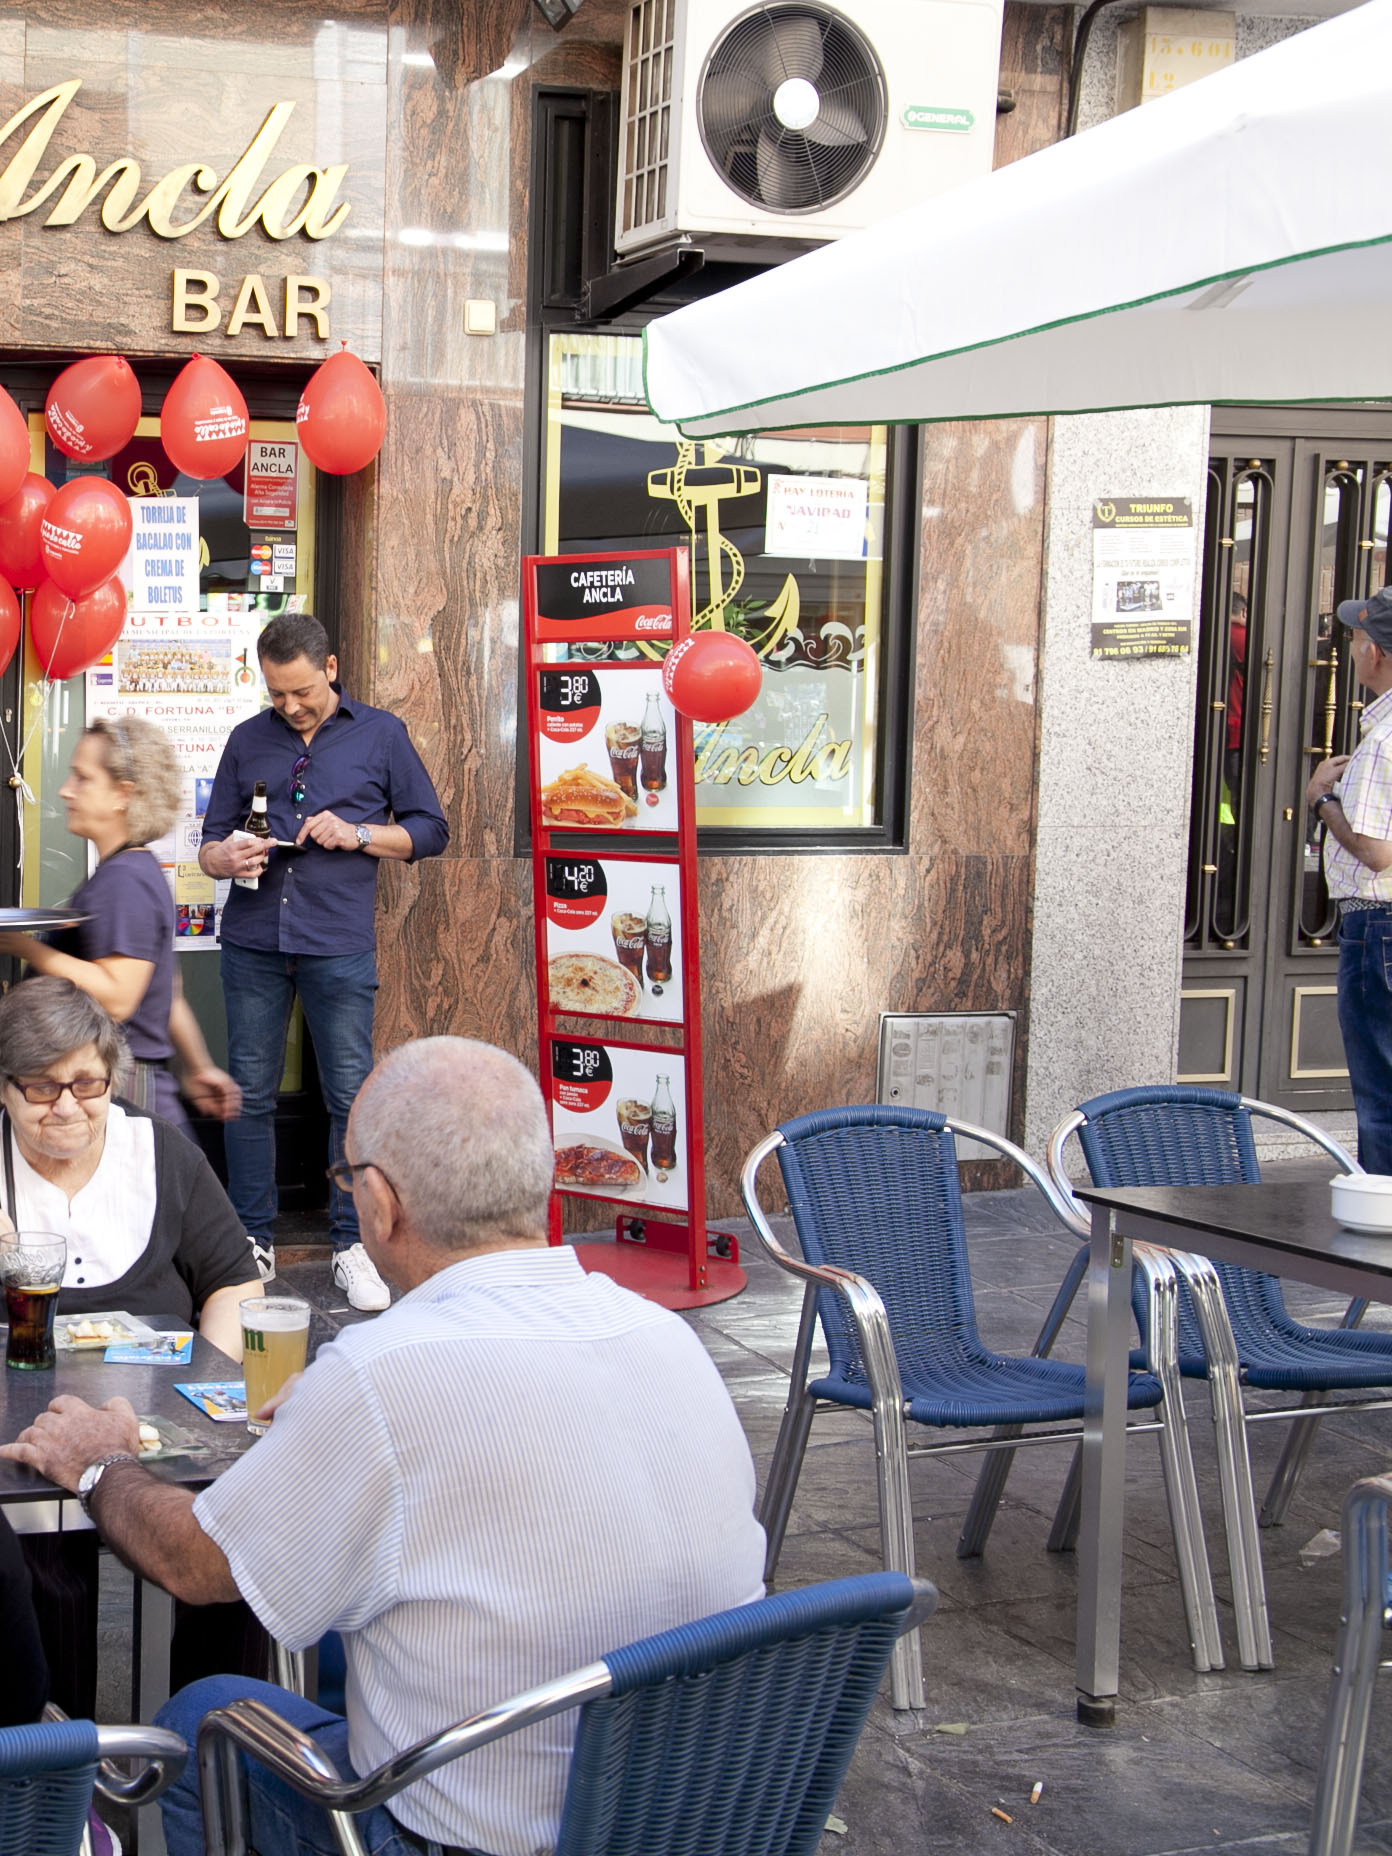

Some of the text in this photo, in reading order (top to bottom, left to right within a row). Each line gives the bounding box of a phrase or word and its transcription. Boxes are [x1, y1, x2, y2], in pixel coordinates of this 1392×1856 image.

[916, 111, 970, 126] GENERAL
[172, 269, 333, 339] BAR
[260, 446, 286, 459] BAR
[251, 462, 294, 474] ANCLA
[141, 506, 186, 524] TORRIJA DE
[786, 504, 851, 518] NAVIDAD
[1129, 503, 1174, 514] TRIUNFO
[1155, 514, 1188, 522] ESTÉTICA
[136, 532, 192, 550] BACALAO CON
[145, 559, 185, 577] CREMA DE
[570, 566, 635, 588] CAFETERÍA
[148, 585, 183, 604] BOLETUS
[583, 587, 623, 603] ANCLA
[130, 616, 241, 627] UTBOL
[635, 614, 673, 630] Coca-Cola
[145, 706, 214, 715] FORTUNA
[167, 725, 232, 734] SERRANILLOS
[610, 745, 639, 759] Coca-Cola
[616, 935, 644, 949] Coca-Cola
[621, 1123, 649, 1135] Coca-Cola
